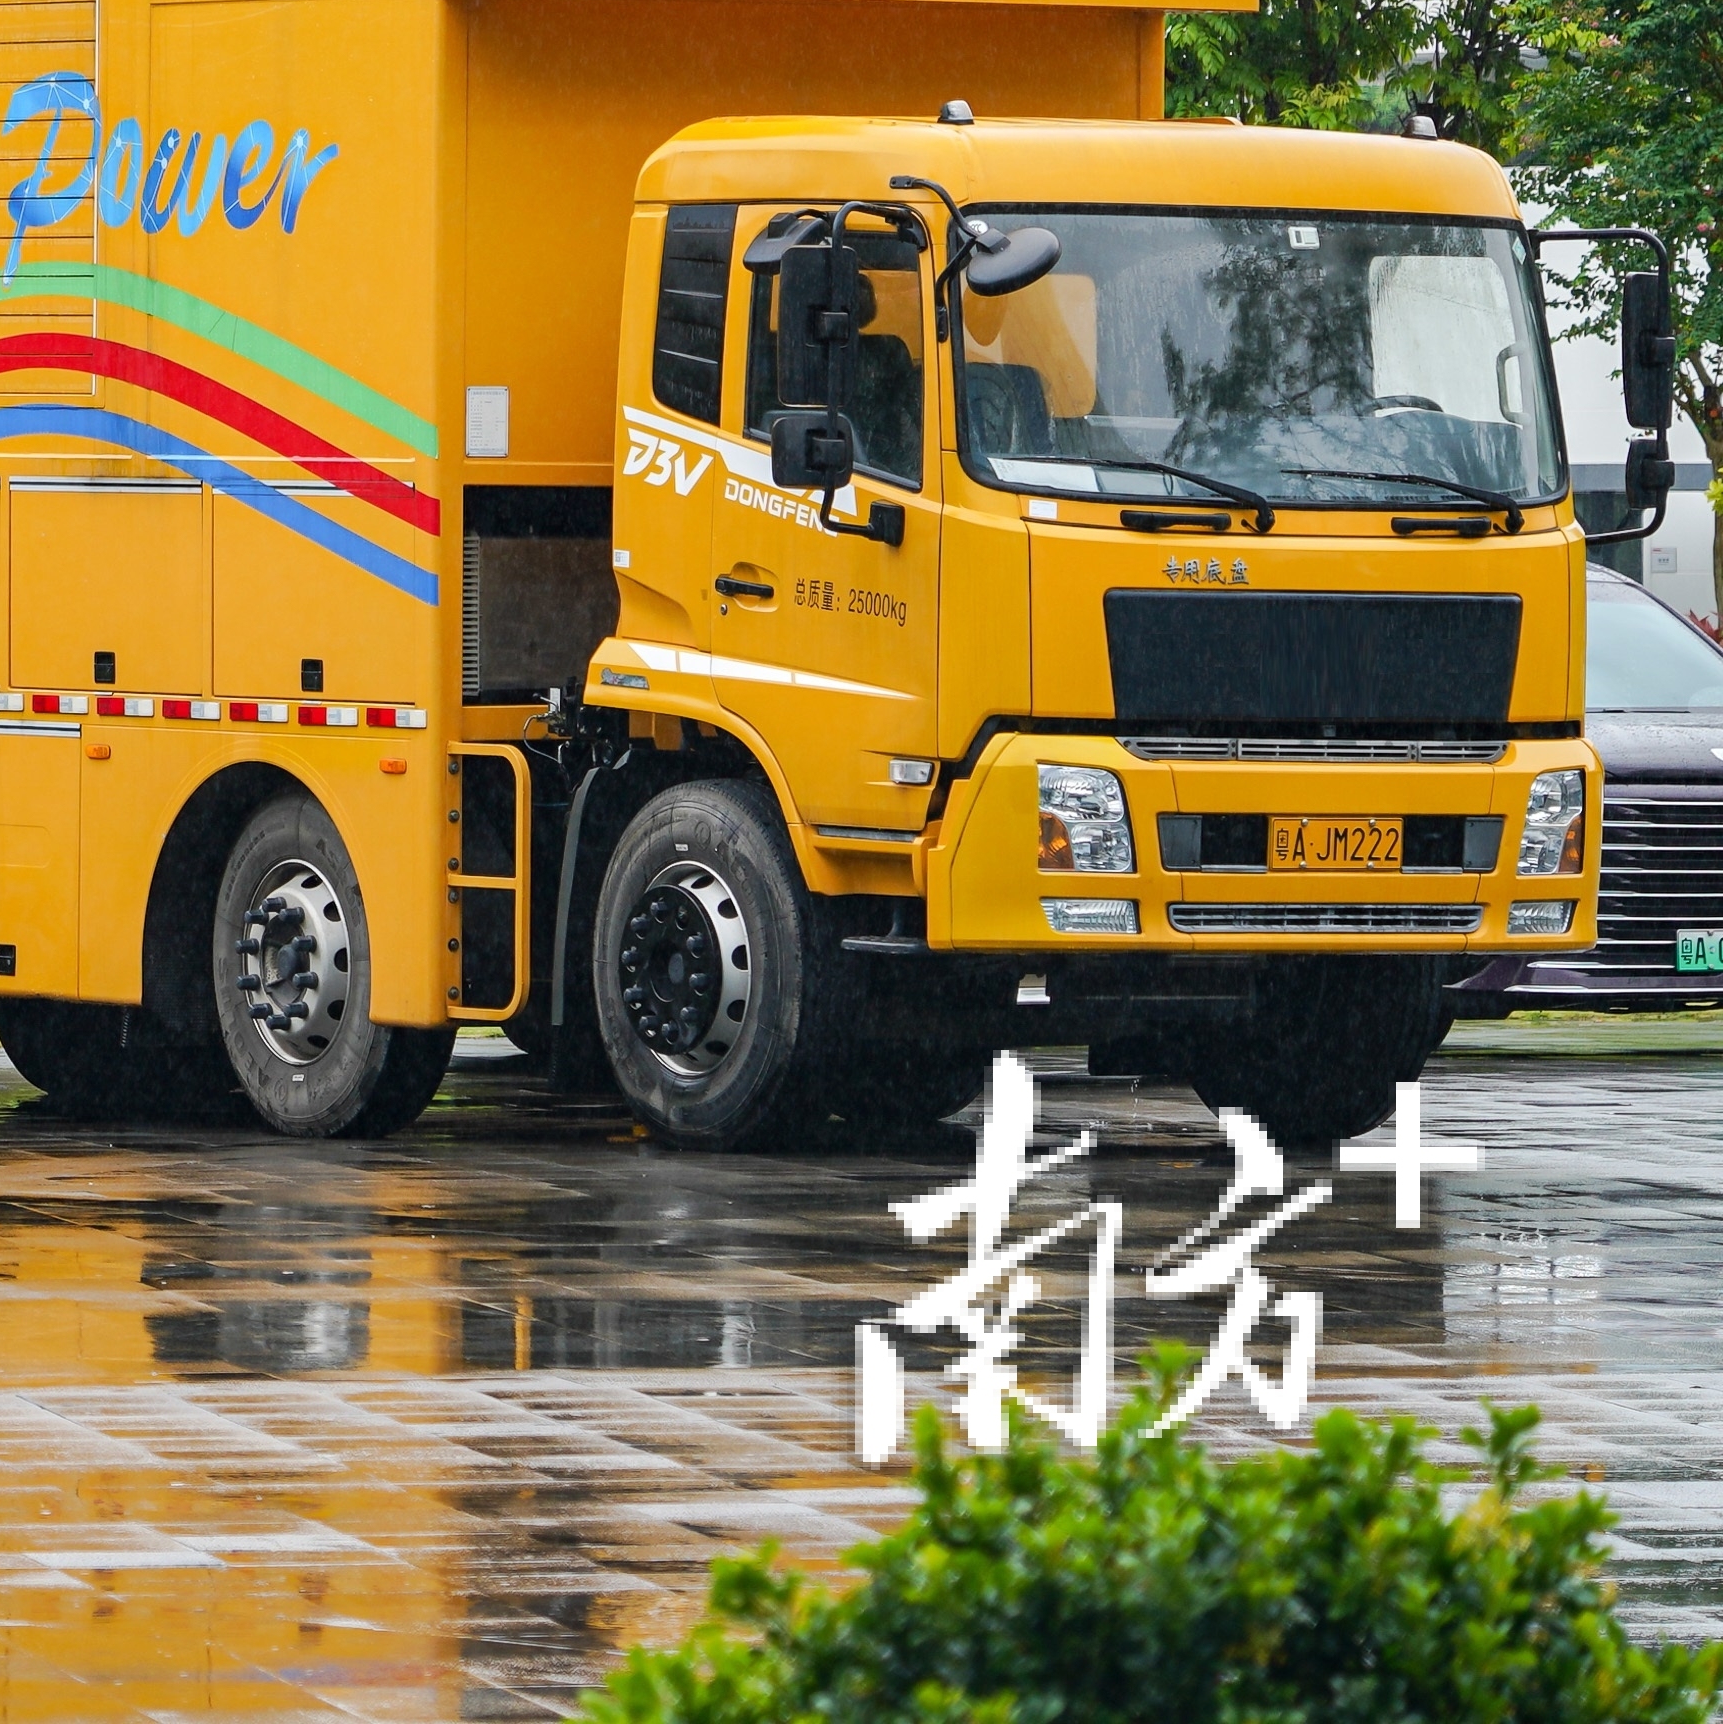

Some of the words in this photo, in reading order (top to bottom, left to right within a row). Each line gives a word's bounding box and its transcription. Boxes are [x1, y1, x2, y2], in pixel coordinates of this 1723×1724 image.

[1, 70, 340, 289] Power
[1162, 556, 1250, 585] 专用底盘
[1680, 937, 1723, 965] 粤A
